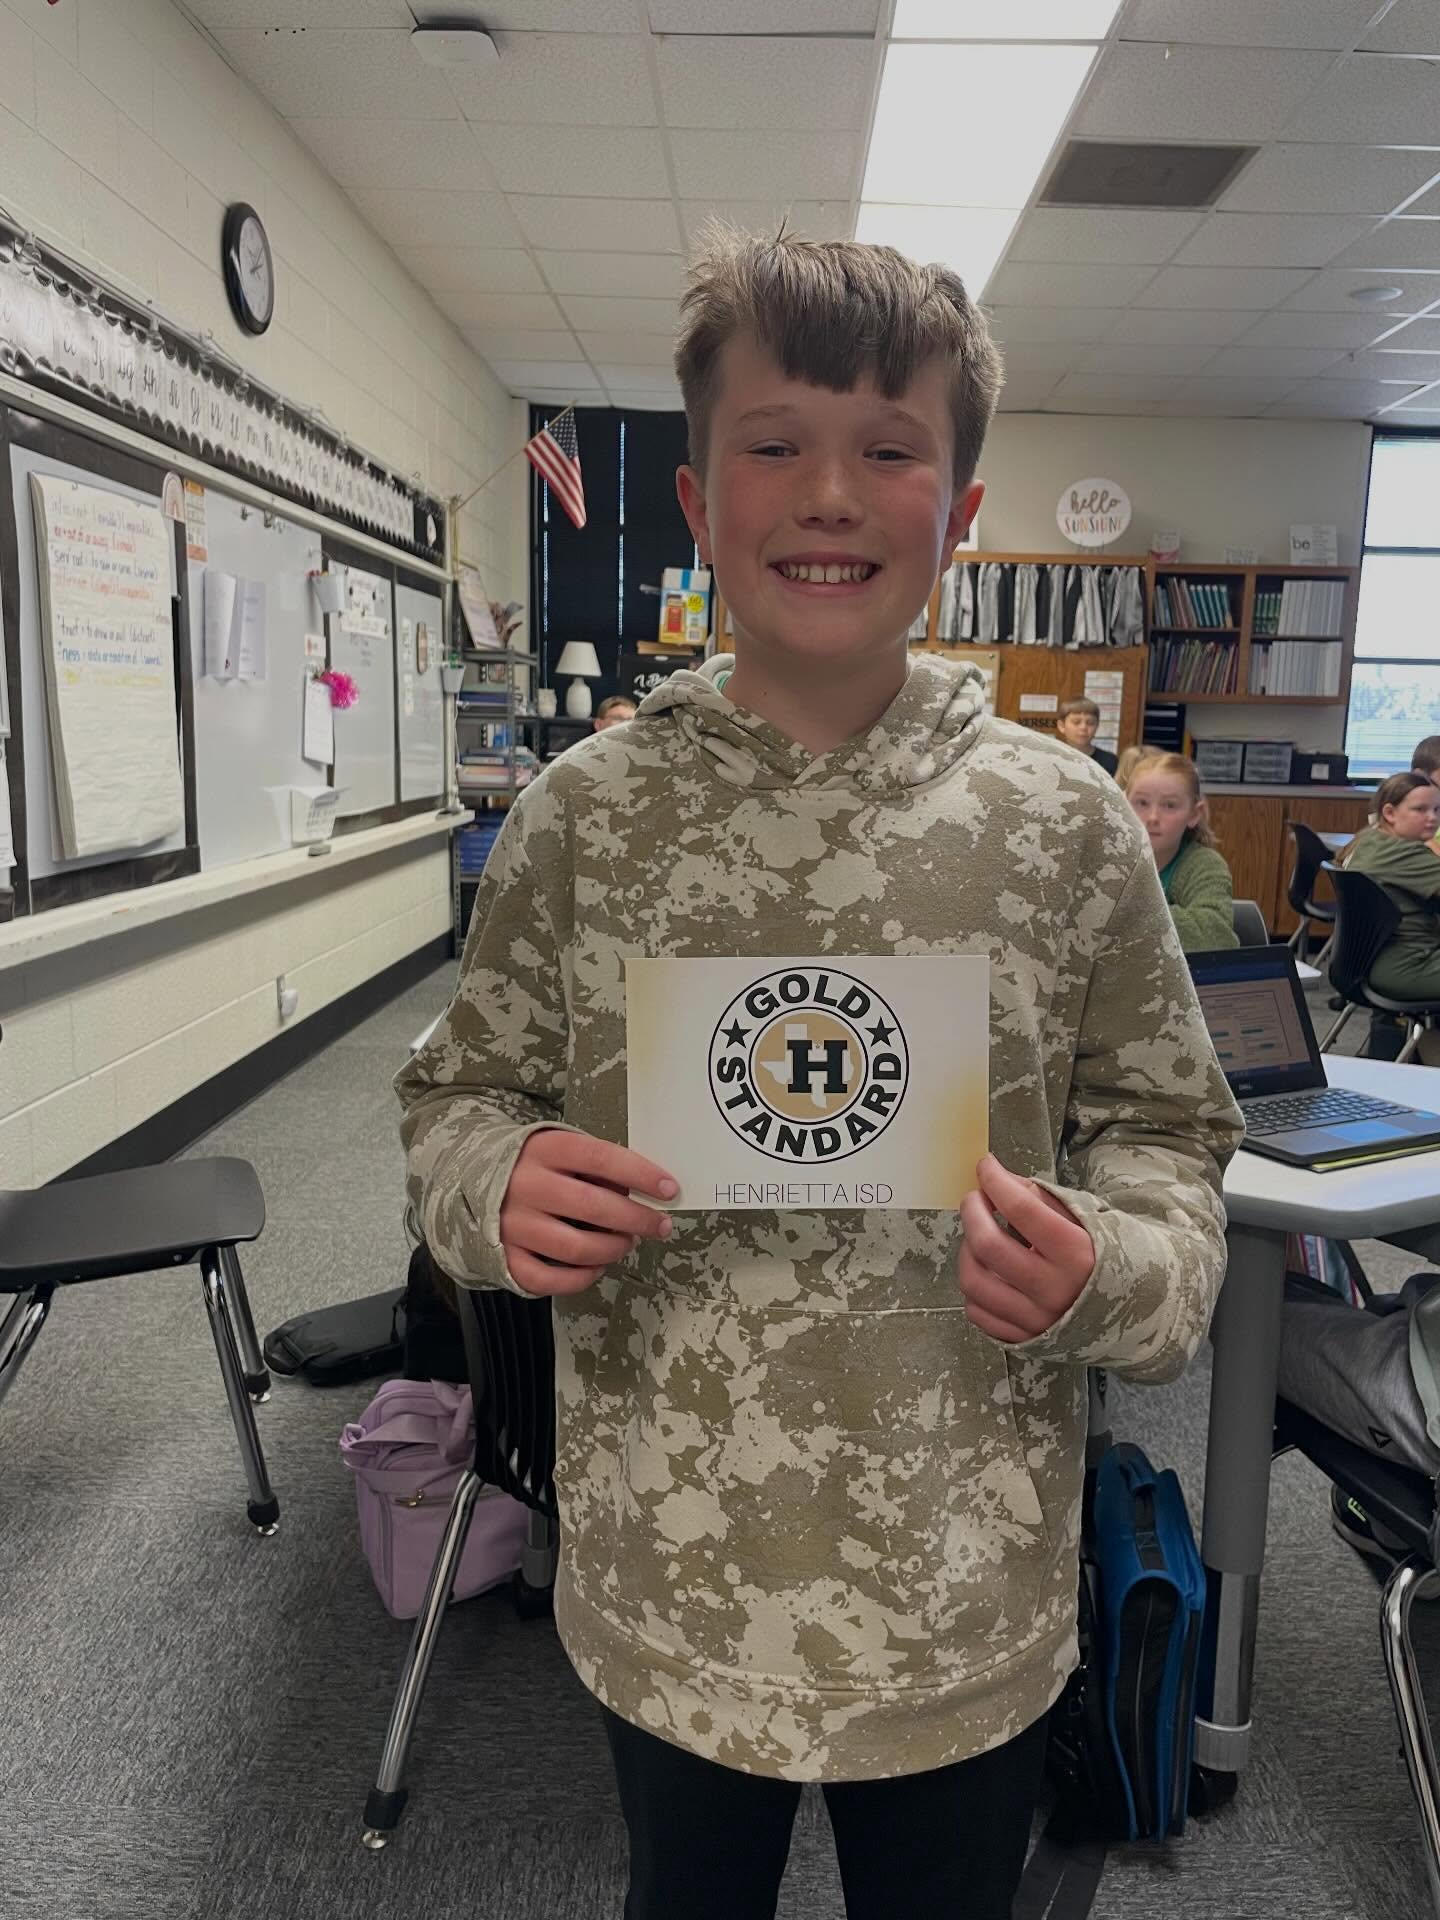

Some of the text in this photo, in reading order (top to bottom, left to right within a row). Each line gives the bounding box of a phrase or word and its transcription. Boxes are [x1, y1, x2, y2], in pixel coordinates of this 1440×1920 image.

[1070, 489, 1121, 515] hello
[1292, 536, 1311, 550] be
[744, 973, 871, 1020] GOLD
[787, 1039, 848, 1093] H
[716, 1052, 902, 1158] STANDARD
[715, 1183, 893, 1204] HENRIETTA ISD
